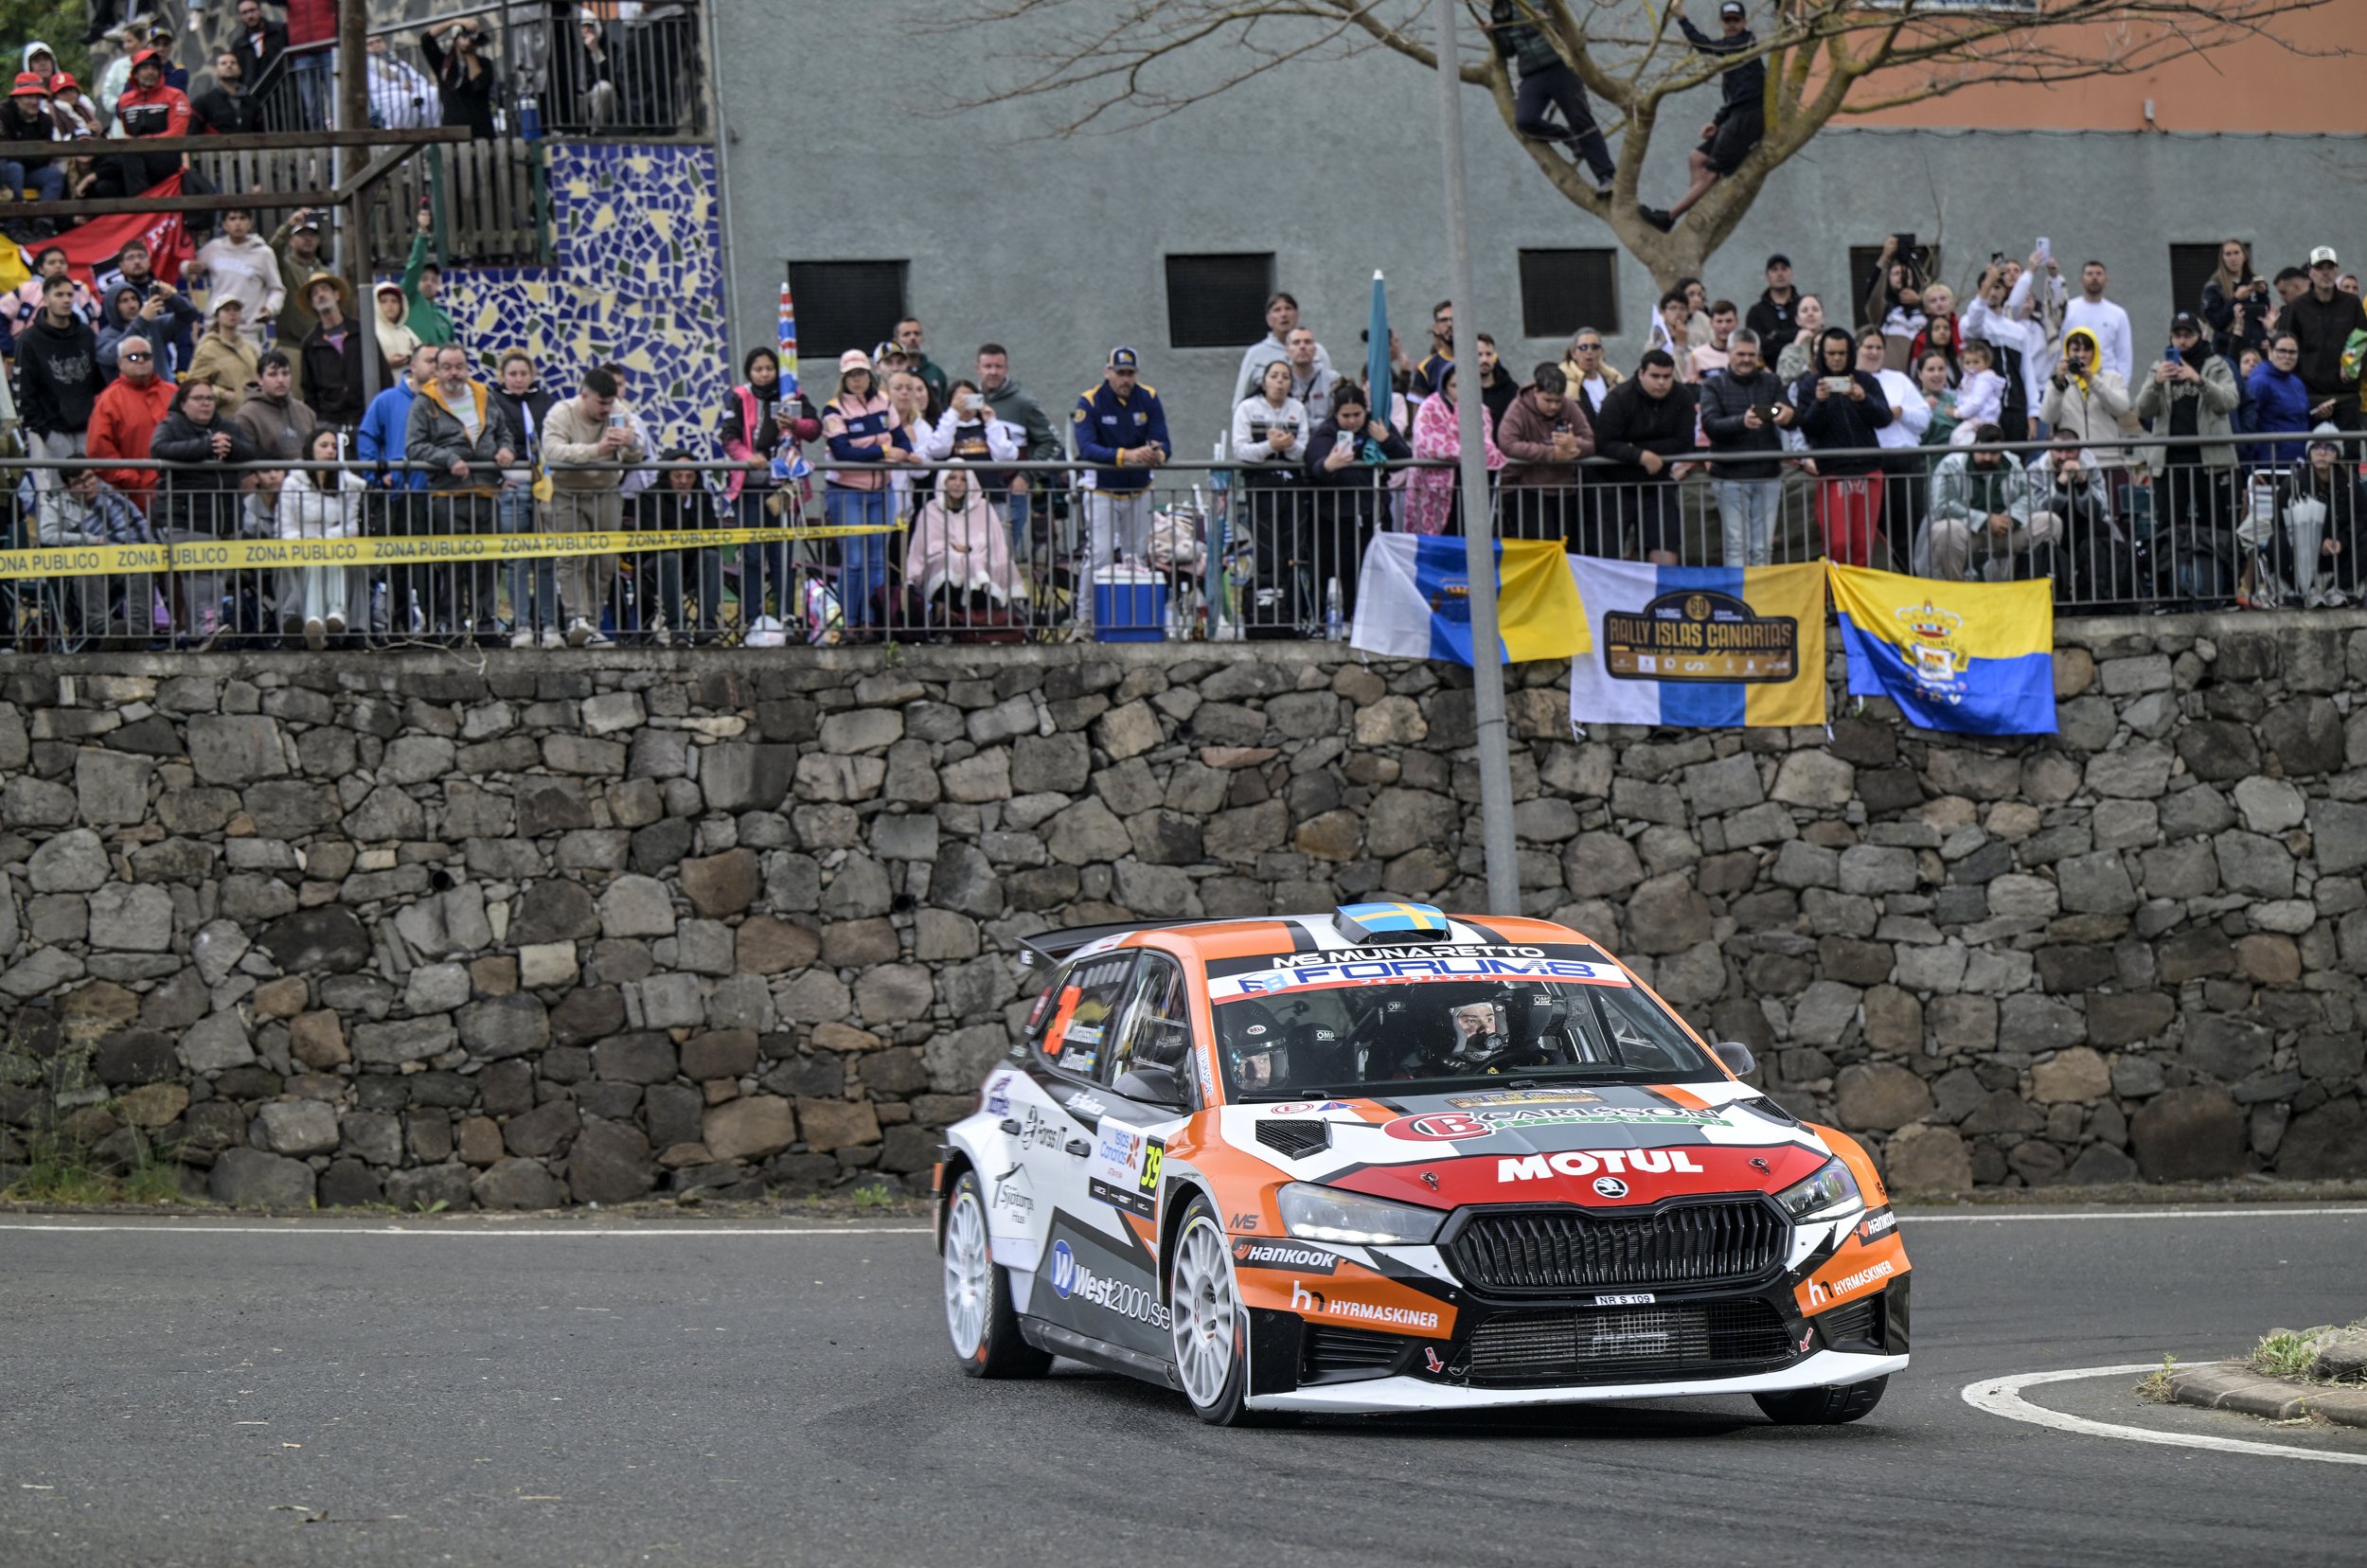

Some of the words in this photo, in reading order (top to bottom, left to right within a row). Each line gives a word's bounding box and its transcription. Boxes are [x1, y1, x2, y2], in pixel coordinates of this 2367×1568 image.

[501, 538, 542, 553] ZONA
[545, 534, 610, 551] PUBLICO
[626, 533, 667, 548] ZONA
[670, 530, 734, 545] PUBLICO
[117, 550, 159, 567] ZONA
[246, 546, 288, 561] ZONA
[293, 543, 358, 561] PUBLICO
[374, 542, 416, 559] ZONA
[419, 540, 485, 556] PUBLICO
[32, 553, 99, 570] PUBLICO
[1610, 617, 1650, 645] RALLY
[1654, 622, 1703, 648] ISLAS
[1706, 623, 1792, 648] CANARIAS
[1272, 953, 1326, 969] MS
[1326, 946, 1546, 964] MUNARETTO
[1292, 959, 1596, 984] FORUM8
[1478, 1107, 1721, 1121] CARLSSON
[1140, 1145, 1164, 1188] 39
[1497, 1149, 1704, 1184] MOTUL
[1229, 1213, 1259, 1230] MS
[1833, 1260, 1895, 1296] HYRMASKINER
[1073, 1263, 1171, 1330] West2000.se
[1620, 1295, 1628, 1304] S
[1630, 1294, 1651, 1304] 109
[1329, 1299, 1438, 1328] HYRMASKINER
